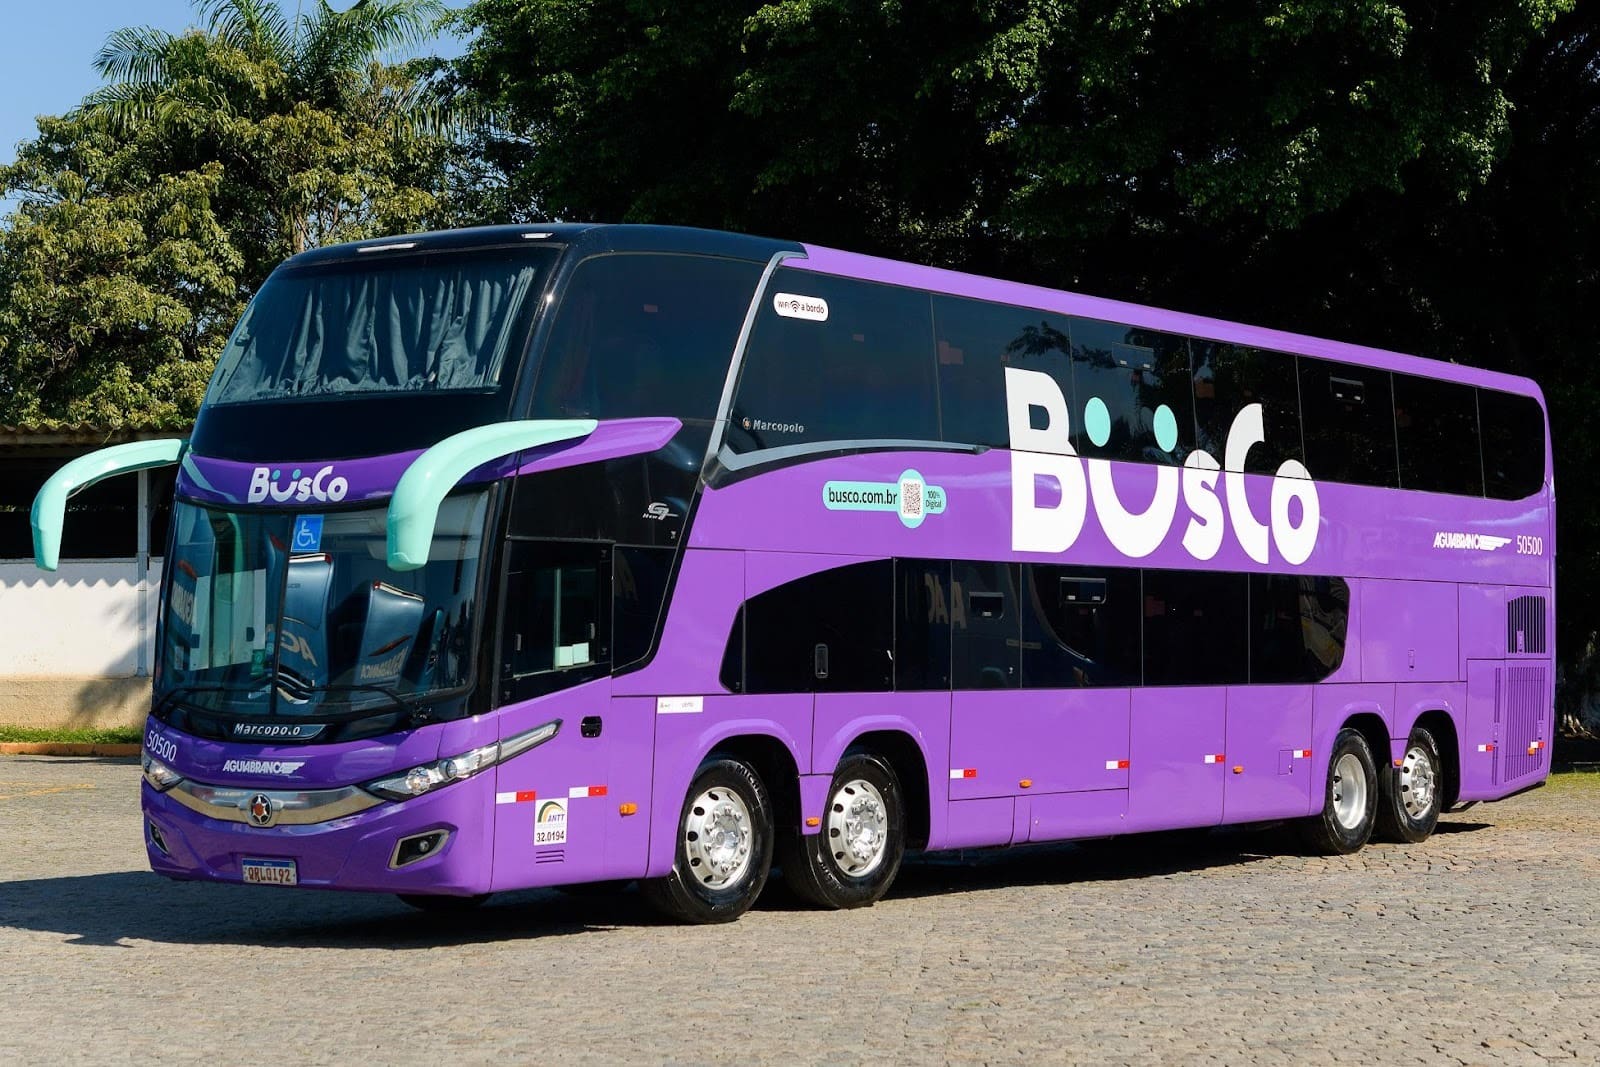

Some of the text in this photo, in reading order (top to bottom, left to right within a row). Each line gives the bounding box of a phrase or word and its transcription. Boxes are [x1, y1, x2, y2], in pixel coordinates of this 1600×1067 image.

[805, 302, 825, 314] bordo
[753, 419, 804, 433] Marcopolo
[828, 487, 898, 505] busco.com.br
[925, 499, 942, 510] Digital
[1516, 535, 1543, 556] 50500
[146, 729, 177, 762] 50500
[547, 813, 565, 822] ANTT
[536, 830, 565, 842] 32.0194
